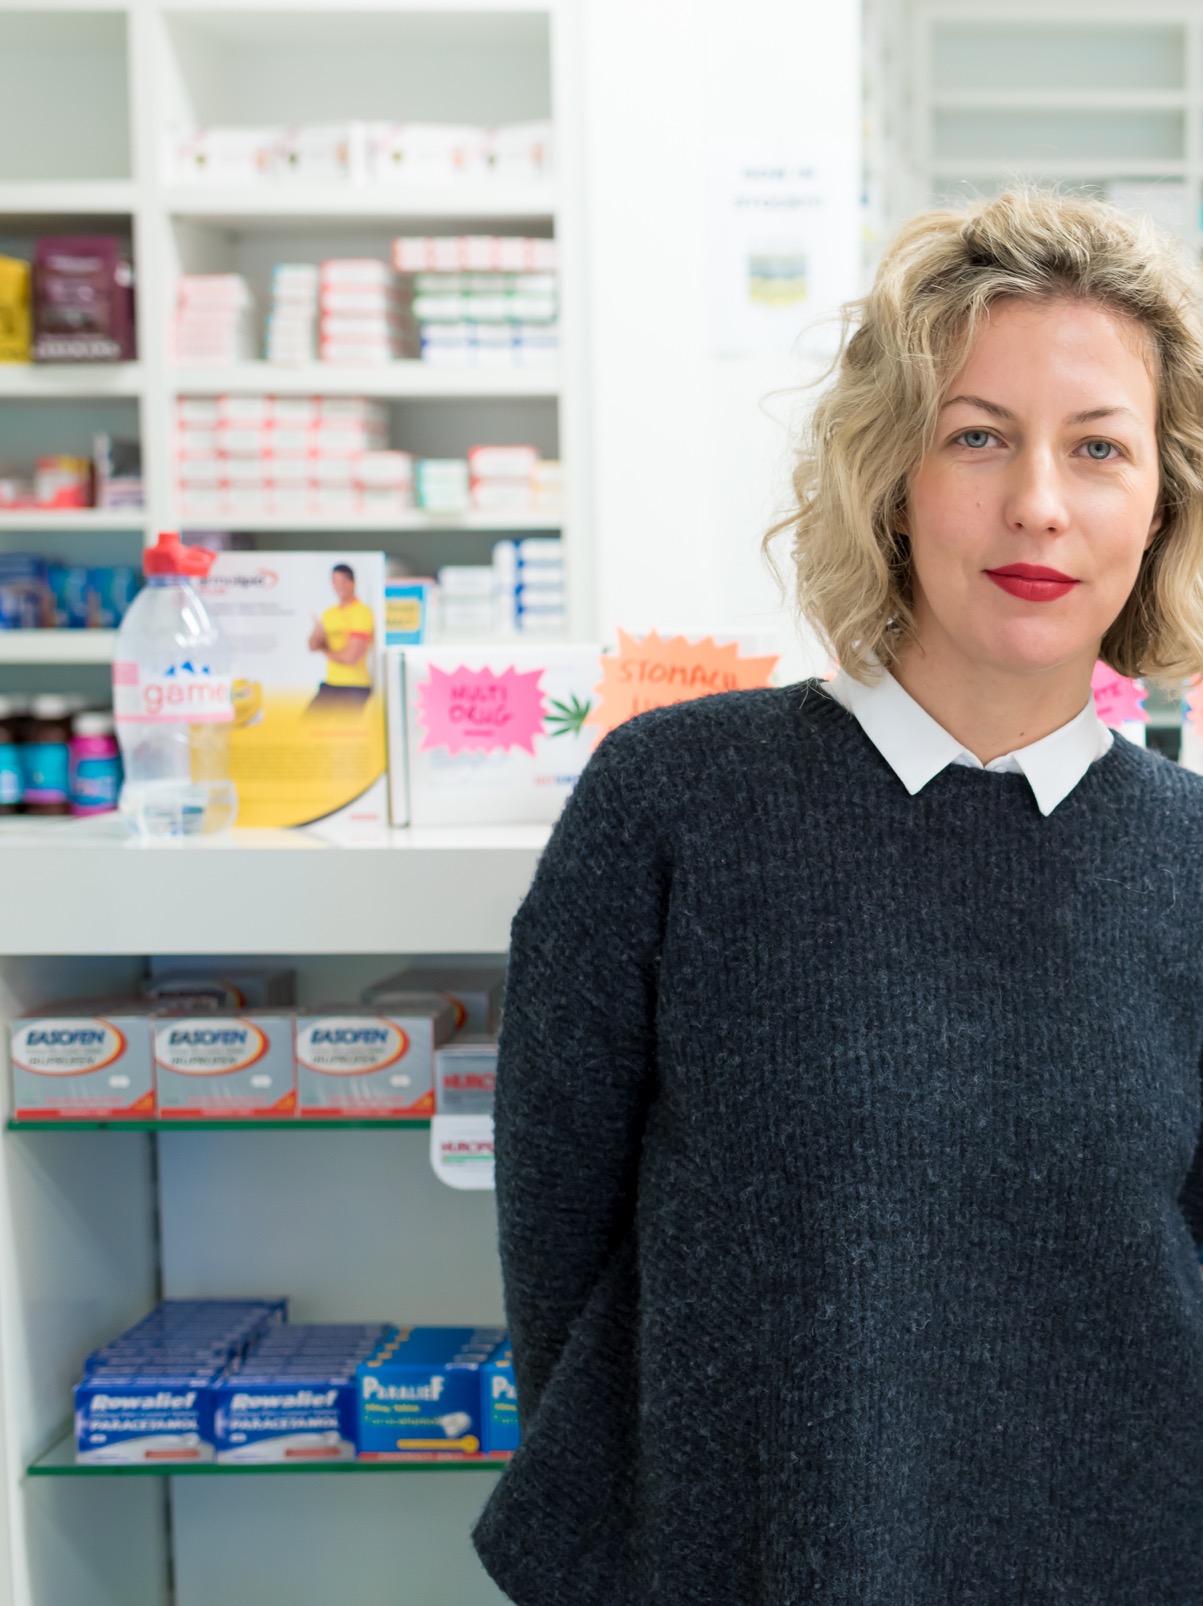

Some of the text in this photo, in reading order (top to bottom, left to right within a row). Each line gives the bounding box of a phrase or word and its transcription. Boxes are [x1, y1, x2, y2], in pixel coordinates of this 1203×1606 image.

[618, 656, 739, 690] STOMACH
[449, 684, 508, 702] MULTI
[26, 1029, 106, 1046] EASOFEN
[169, 1028, 248, 1046] EASOFEN
[309, 1028, 390, 1045] EASOFEN
[91, 1392, 197, 1412] Rowalief
[231, 1390, 338, 1411] Rowalief
